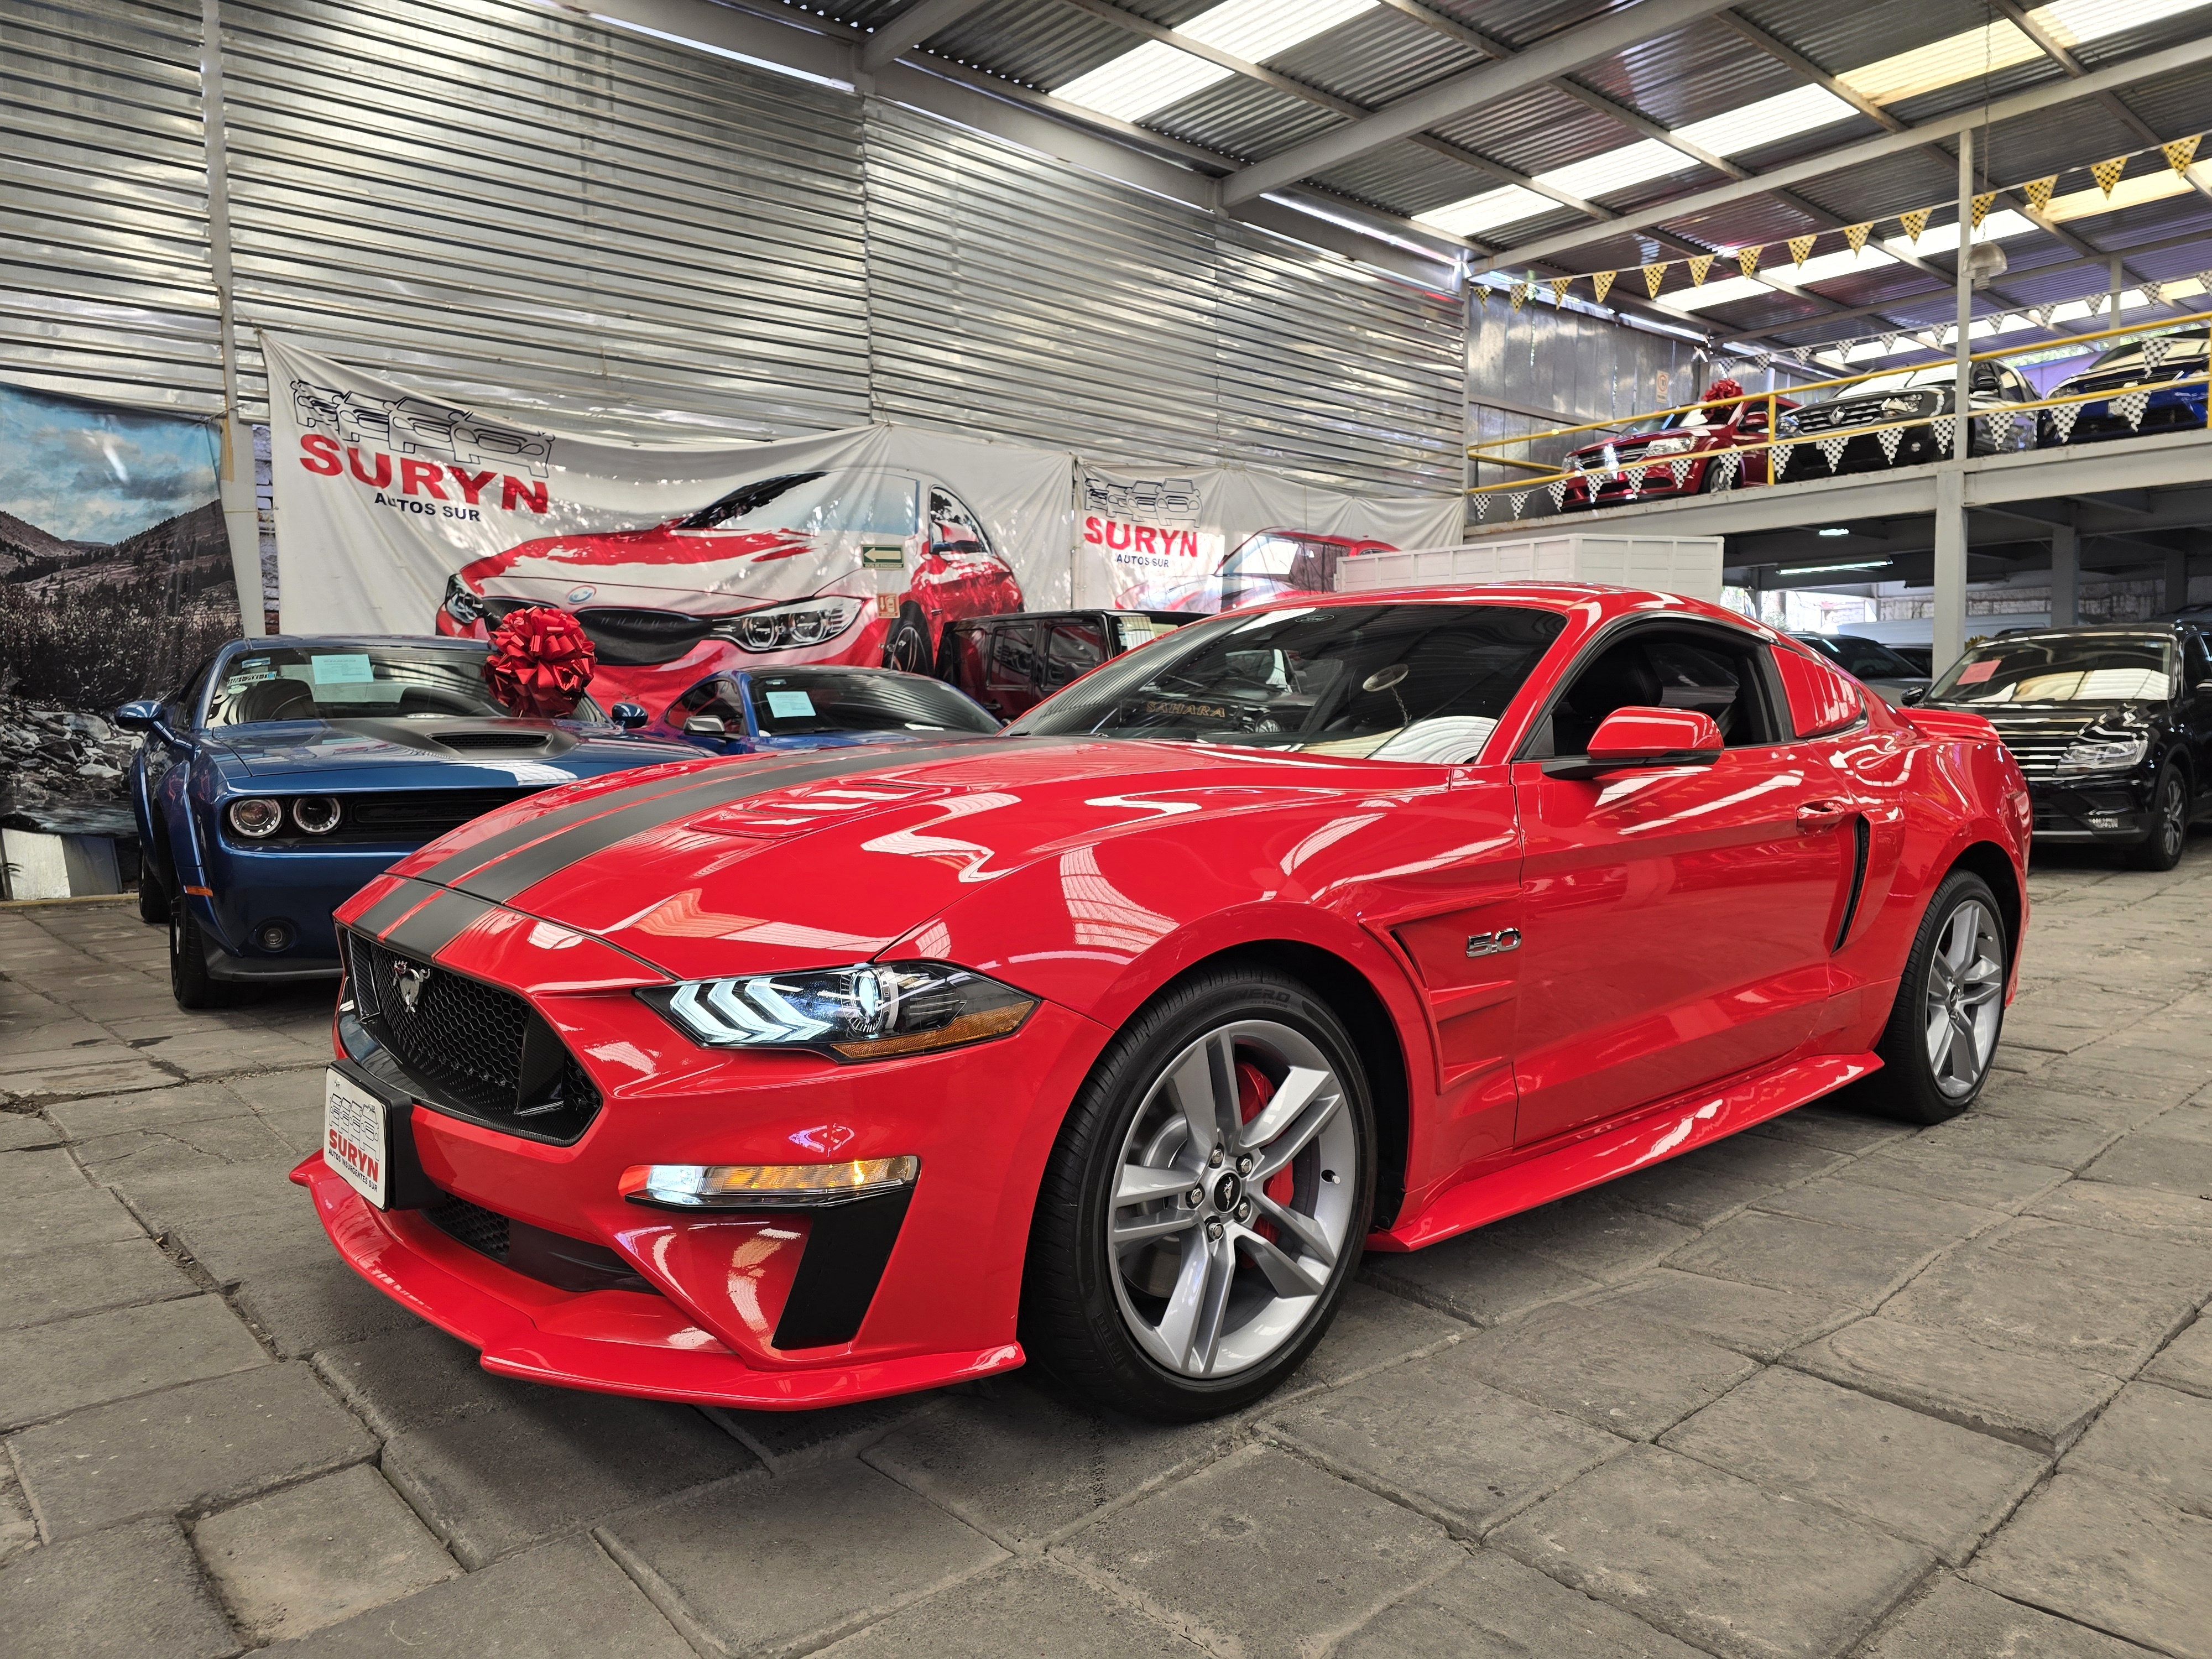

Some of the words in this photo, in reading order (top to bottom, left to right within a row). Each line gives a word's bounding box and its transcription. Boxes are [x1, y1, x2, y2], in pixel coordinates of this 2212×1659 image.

[300, 434, 549, 514] SURYN
[374, 492, 436, 515] AUTOS
[442, 505, 481, 521] SUR
[1084, 515, 1198, 558] SURYN
[1117, 554, 1149, 566] AUTOS
[1152, 557, 1169, 567] SUR
[1146, 701, 1225, 718] SAHARA
[1465, 927, 1522, 958] 5.0
[328, 1147, 341, 1162] AUTOS
[341, 1159, 368, 1185] INSURGENTES
[368, 1180, 378, 1192] SUR
[329, 1129, 379, 1183] SURYN
